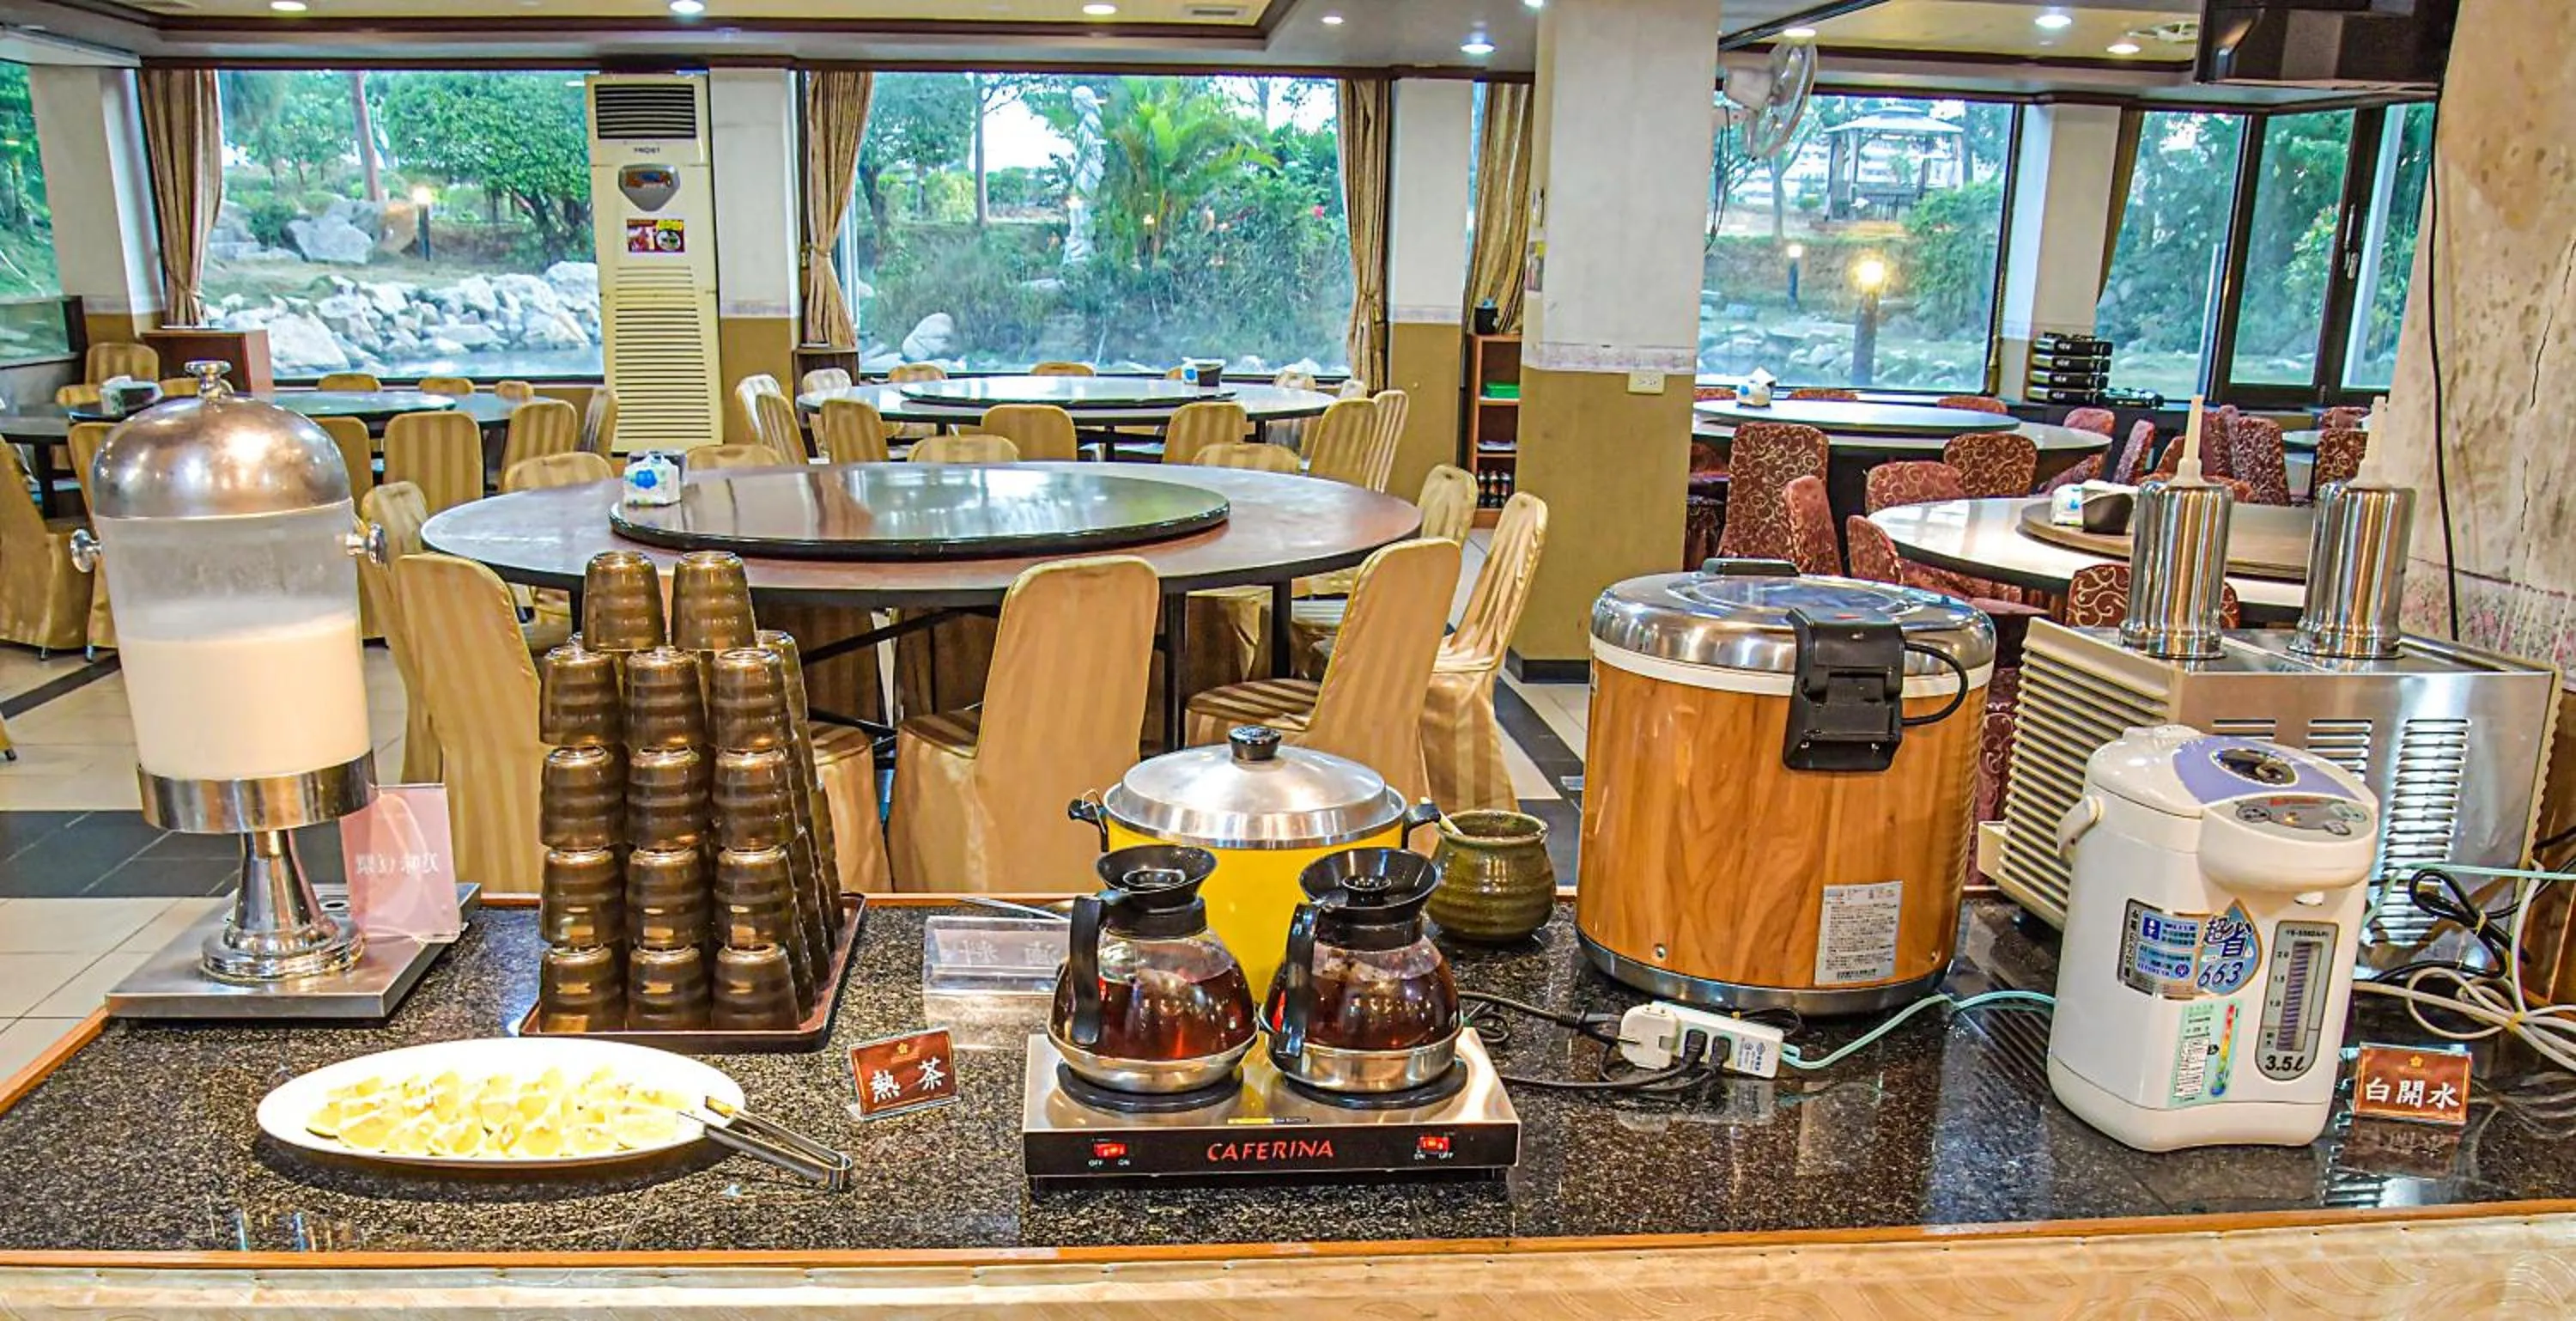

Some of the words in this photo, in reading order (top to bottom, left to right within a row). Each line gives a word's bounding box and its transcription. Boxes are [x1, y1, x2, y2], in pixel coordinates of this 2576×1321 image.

[2196, 961, 2244, 987] 663
[870, 1056, 946, 1104] 熱茶
[2366, 1076, 2461, 1111] 白開水
[1206, 1140, 1334, 1161] CAFERINA
